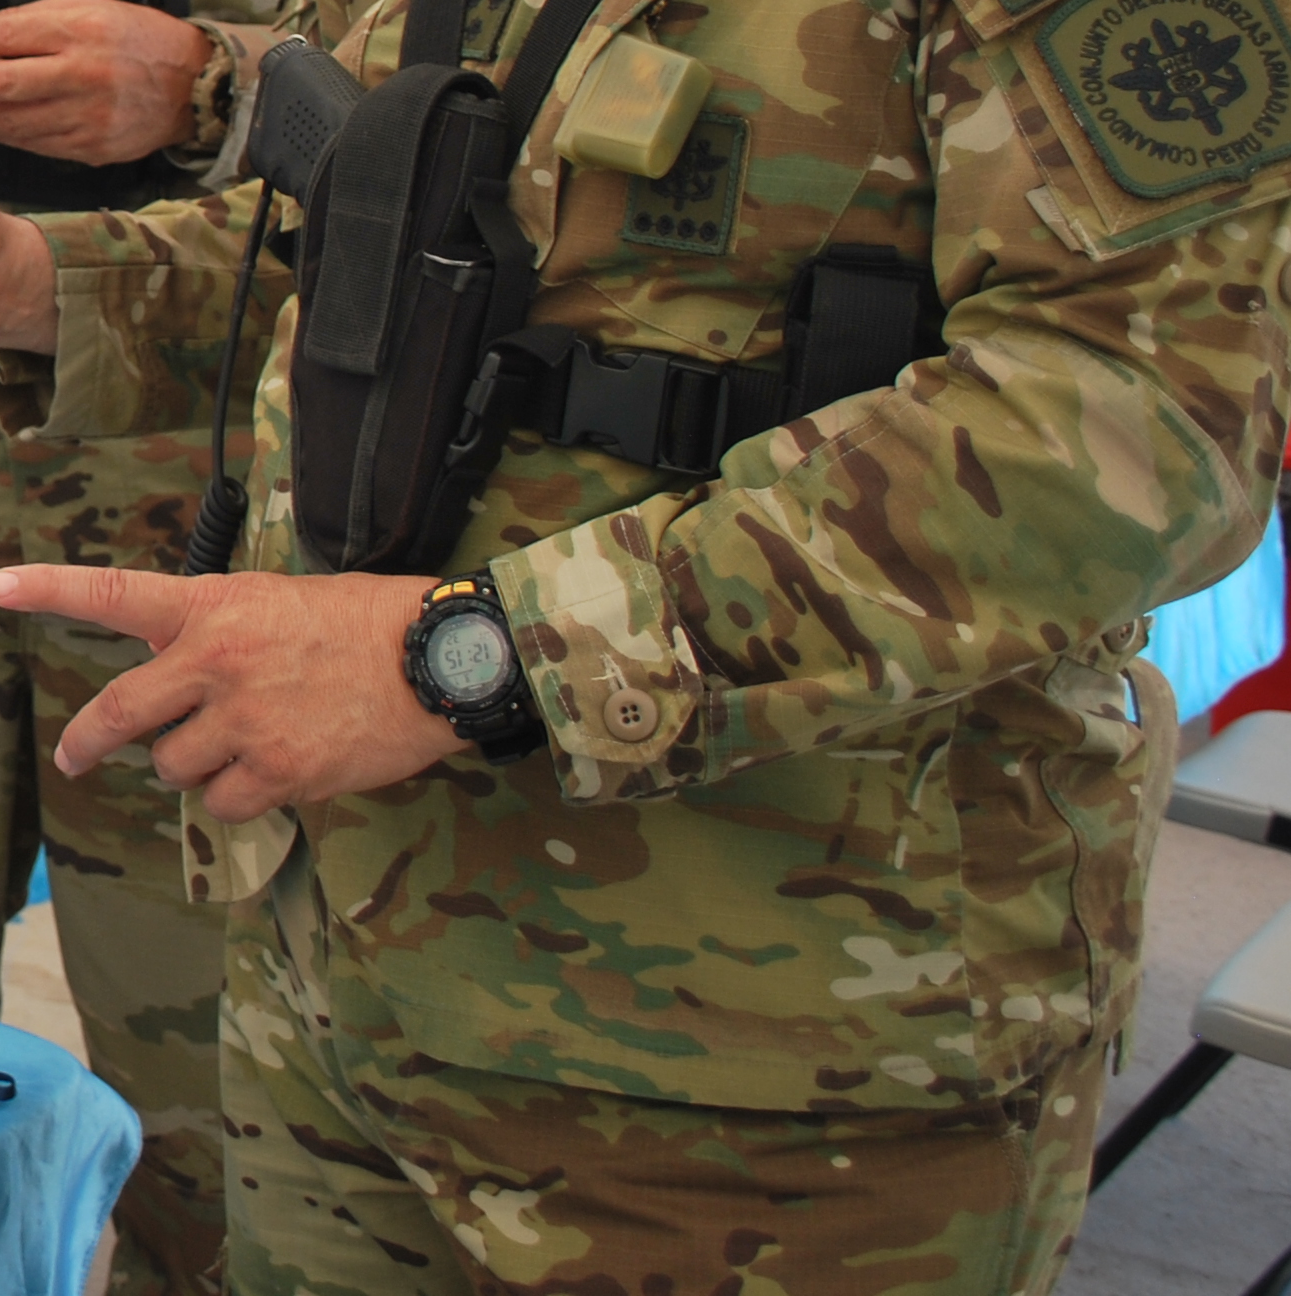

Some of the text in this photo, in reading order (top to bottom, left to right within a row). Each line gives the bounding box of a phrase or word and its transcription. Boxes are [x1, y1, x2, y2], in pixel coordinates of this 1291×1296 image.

[1079, 6, 1123, 107] CONJUNTO
[1252, 48, 1291, 138] ARMADAS
[1095, 106, 1199, 167] COMANDO
[1201, 132, 1264, 168] PERU
